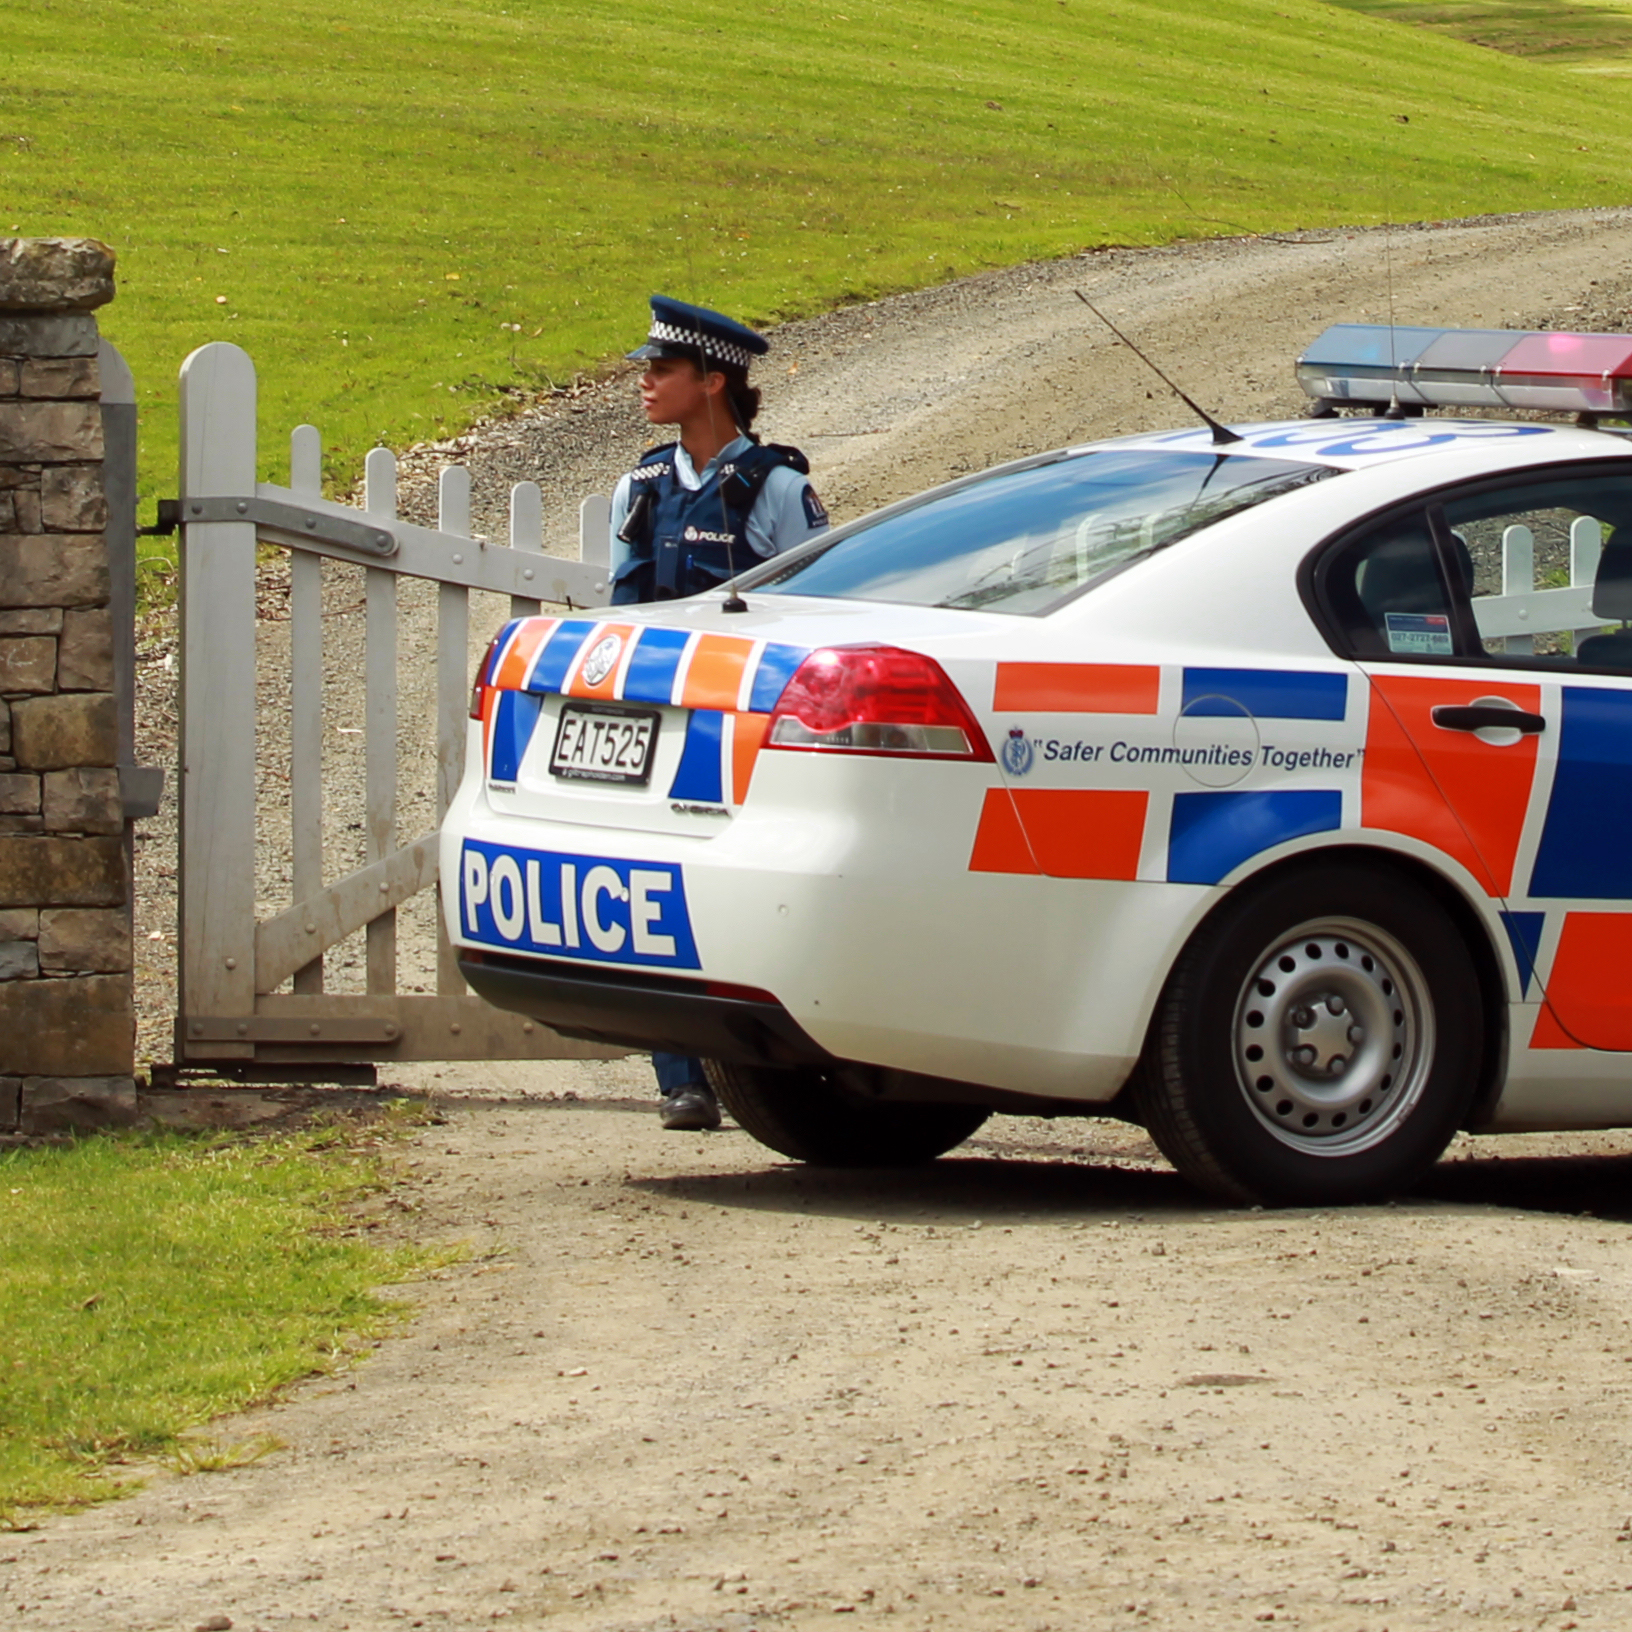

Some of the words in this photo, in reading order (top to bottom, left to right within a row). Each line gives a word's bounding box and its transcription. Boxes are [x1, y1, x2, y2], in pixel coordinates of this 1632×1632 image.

[699, 530, 736, 543] POLICE
[558, 718, 649, 768] EAT525
[1110, 741, 1253, 766] Communities
[464, 849, 677, 956] POLICE
